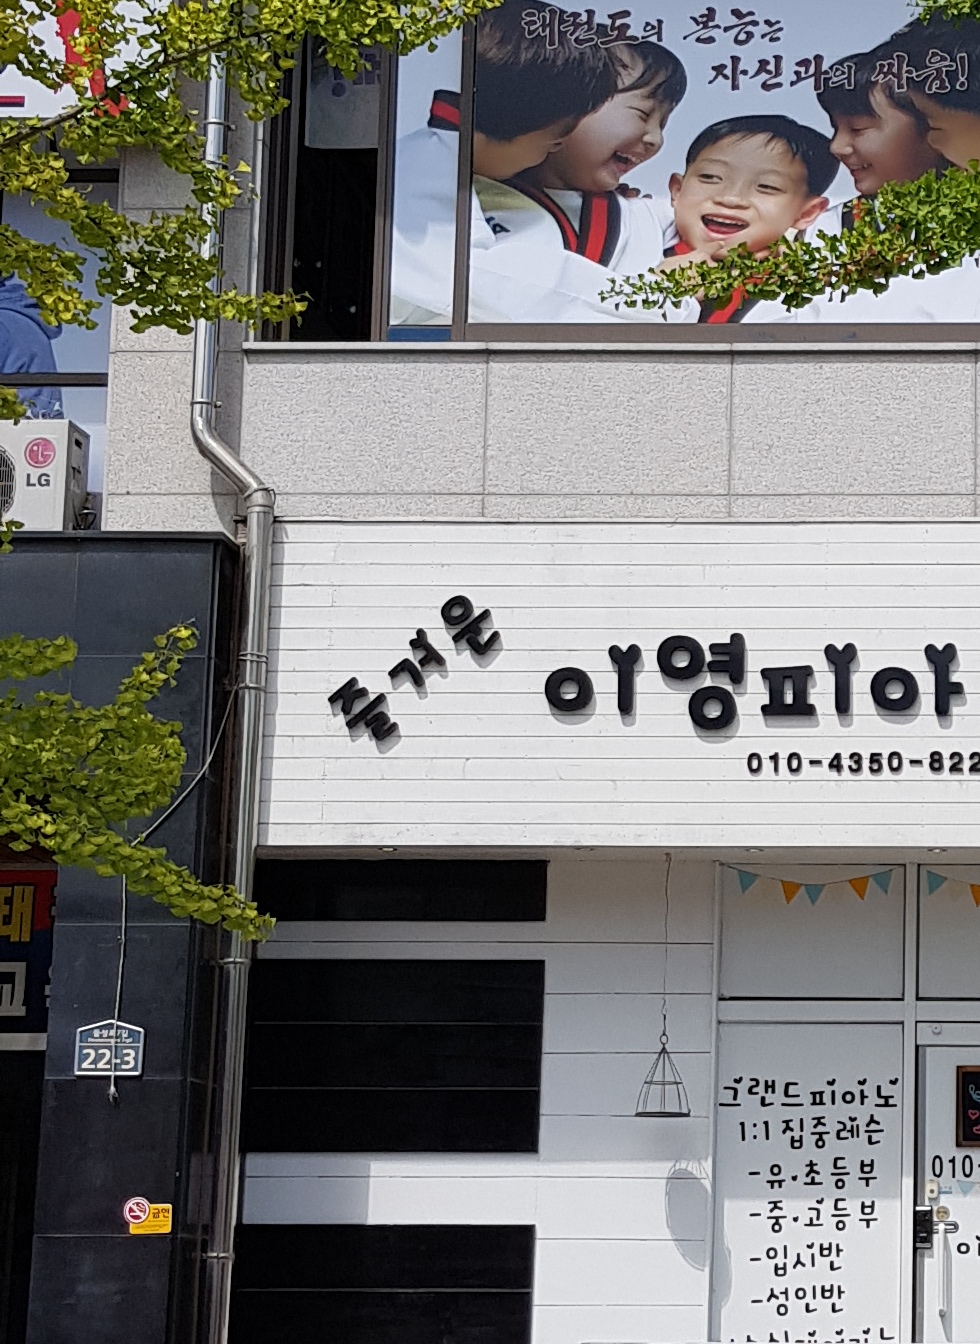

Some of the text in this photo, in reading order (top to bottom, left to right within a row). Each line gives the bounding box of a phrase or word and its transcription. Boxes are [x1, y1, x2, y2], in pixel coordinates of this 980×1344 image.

[520, 6, 664, 49] 태권도의
[707, 50, 969, 95] 자신과의 싸움!
[26, 473, 51, 488] LG
[327, 594, 502, 744] 즐거운
[81, 1048, 136, 1070] 22-3
[719, 1076, 899, 1108] 그랜드피아노
[738, 1113, 885, 1150] 1:1 집중레슨
[151, 1207, 170, 1219] 금연
